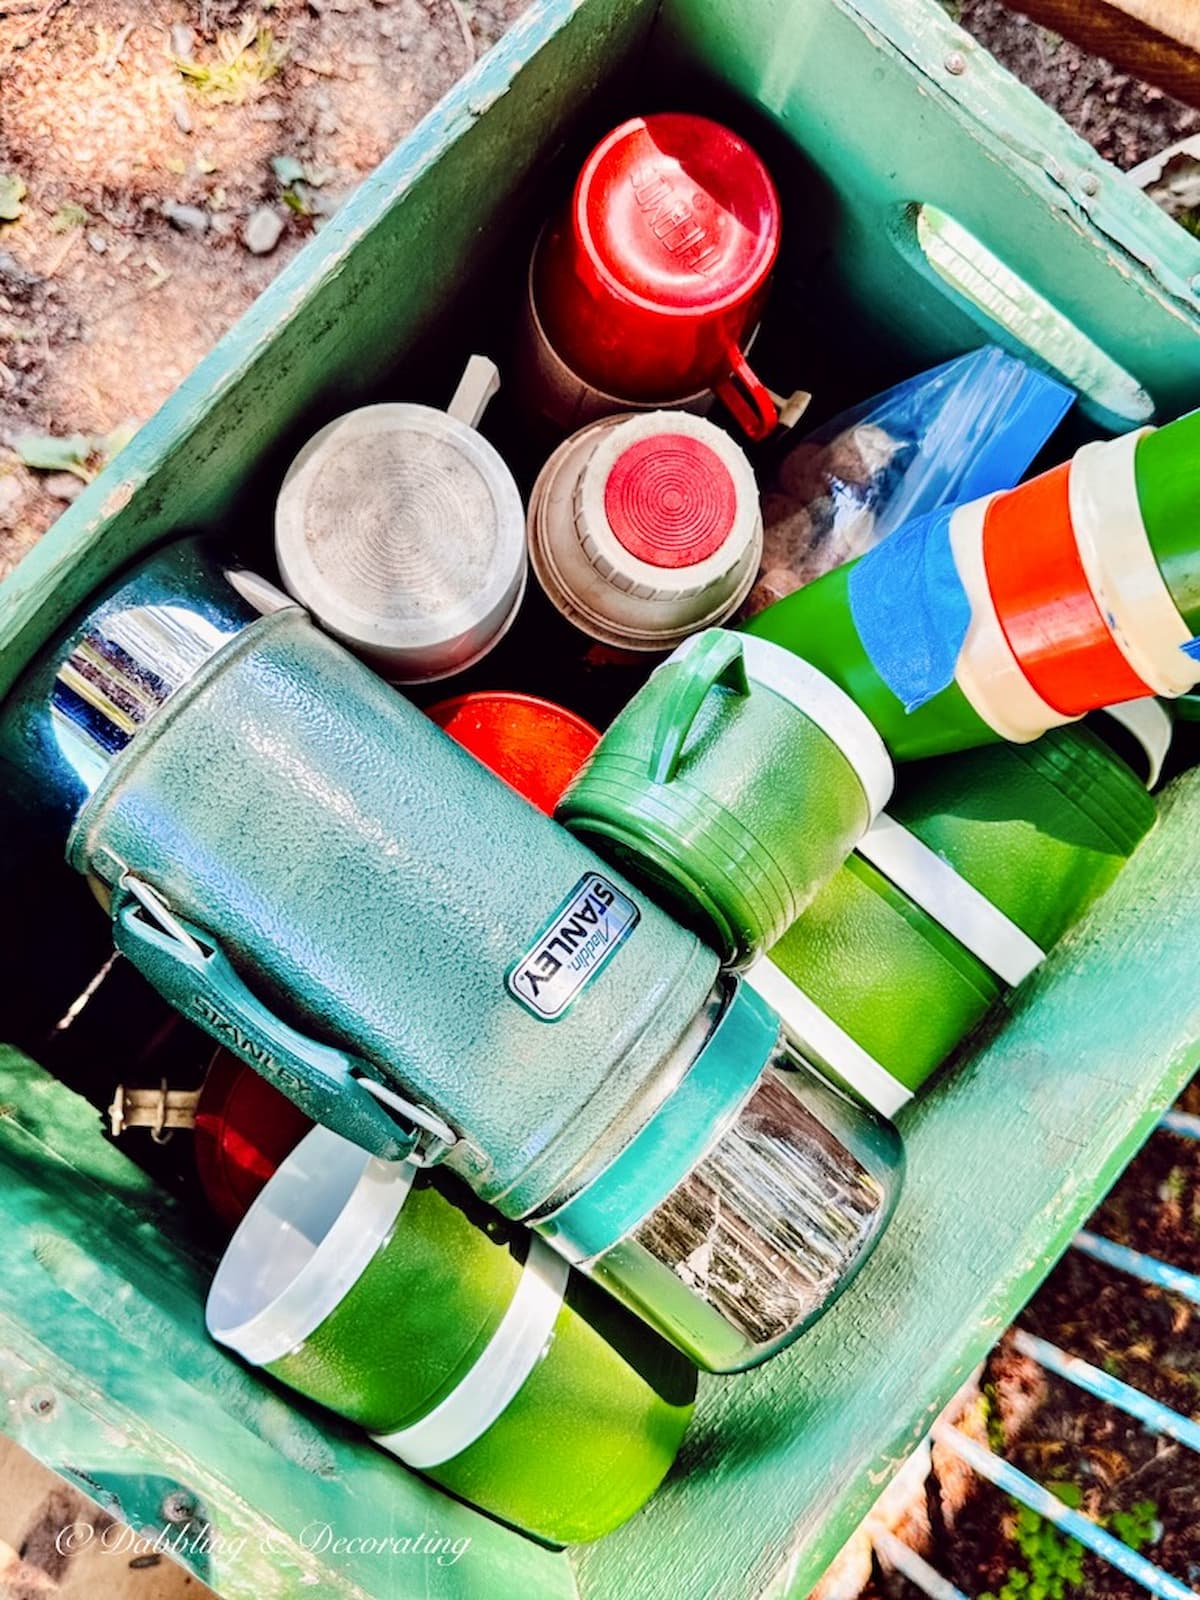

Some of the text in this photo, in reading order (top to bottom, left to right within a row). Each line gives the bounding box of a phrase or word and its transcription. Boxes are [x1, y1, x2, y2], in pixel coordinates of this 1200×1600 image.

[523, 882, 615, 997] STANLEY
[570, 918, 609, 971] Aladdin
[191, 996, 312, 1093] STANLEY
